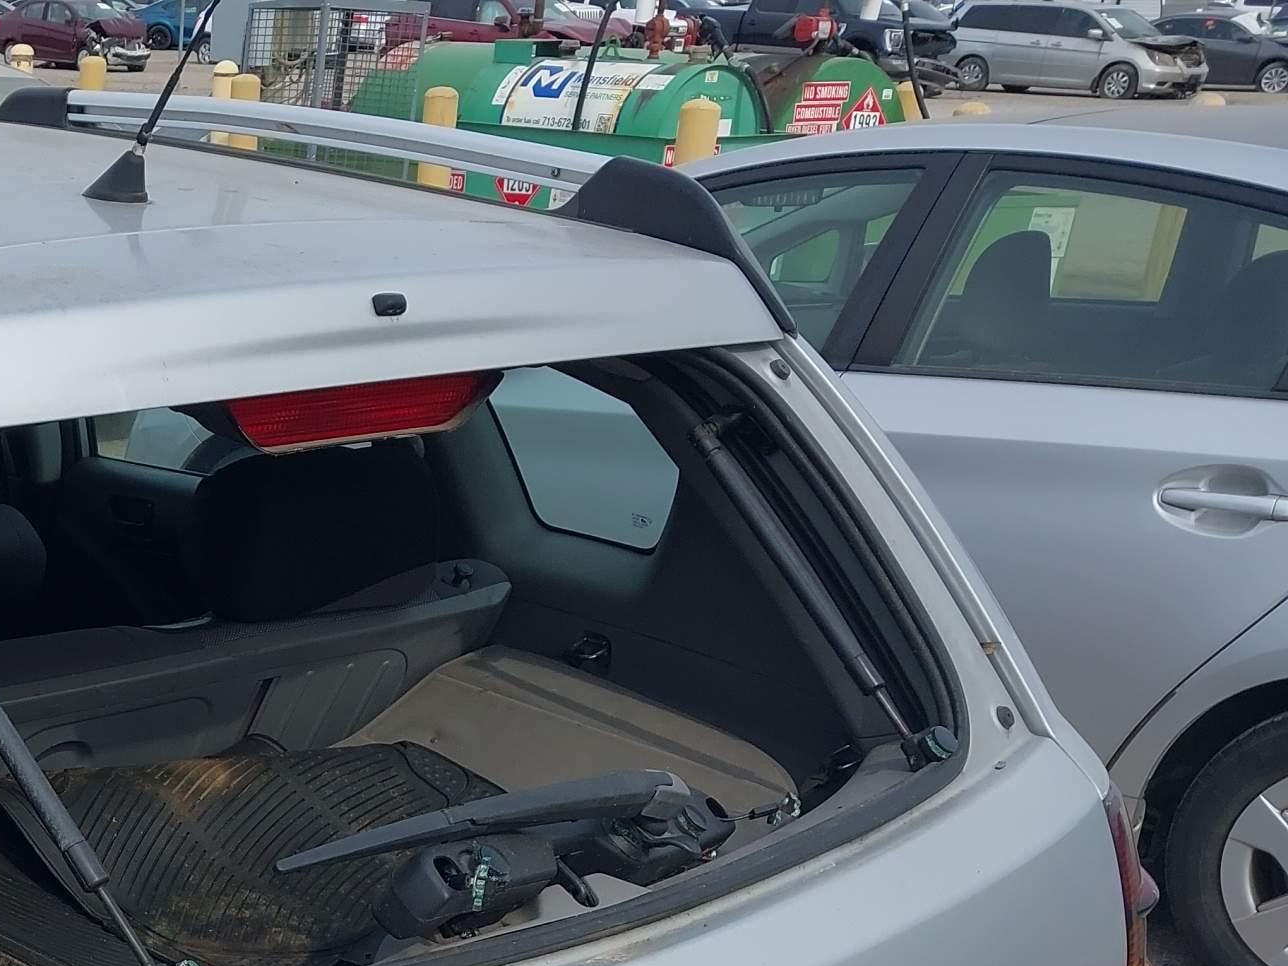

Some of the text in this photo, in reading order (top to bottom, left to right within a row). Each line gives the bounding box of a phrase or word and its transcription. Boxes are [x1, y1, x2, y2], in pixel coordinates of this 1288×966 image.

[804, 85, 849, 99] NO SMOKING
[795, 106, 841, 119] COMBUSTIBLE
